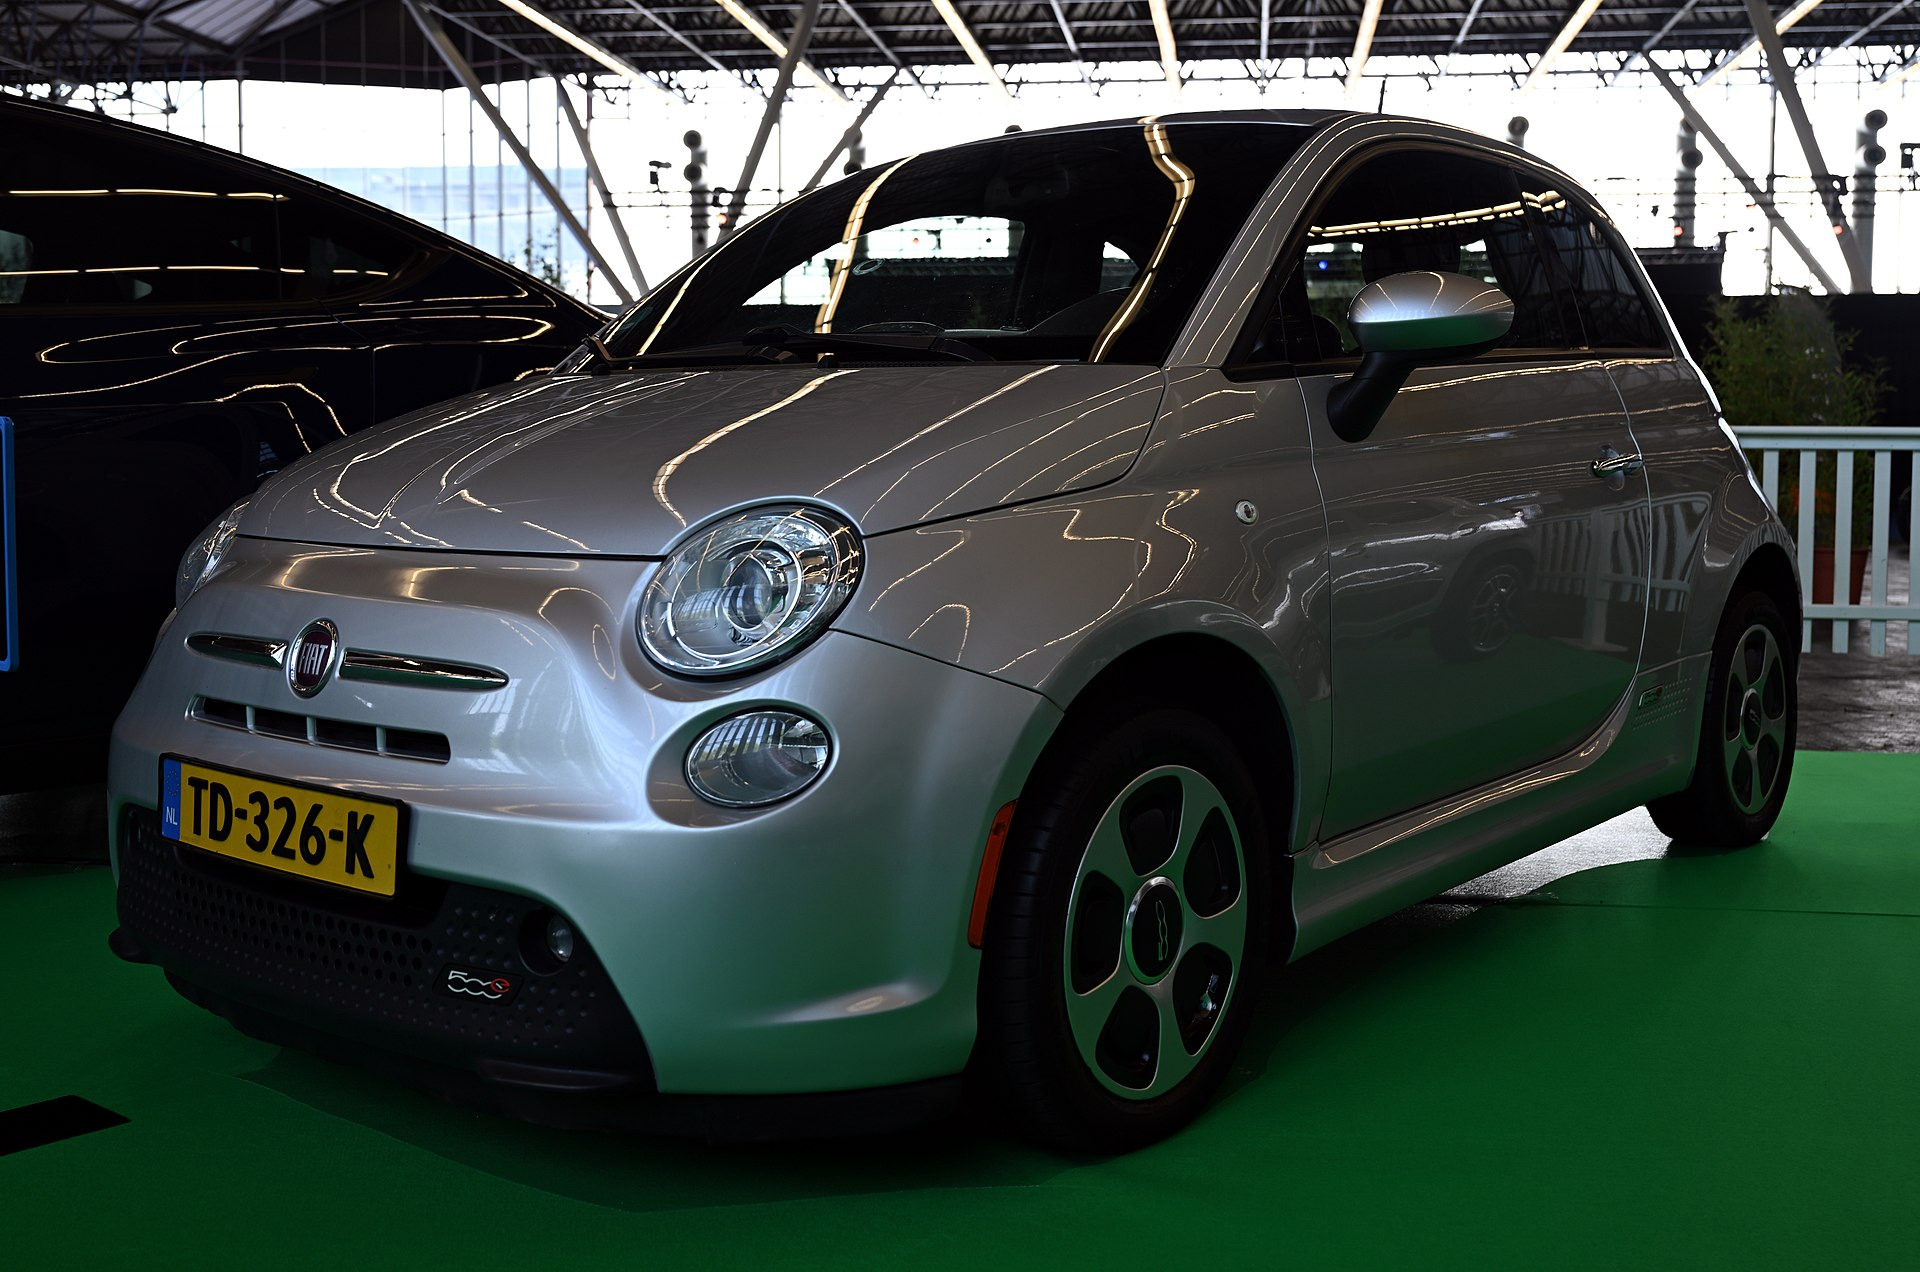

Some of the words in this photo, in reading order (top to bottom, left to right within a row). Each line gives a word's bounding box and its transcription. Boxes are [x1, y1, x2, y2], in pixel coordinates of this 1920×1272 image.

[297, 642, 329, 676] FIAT
[165, 805, 178, 826] NL
[187, 776, 375, 879] TD-326-K
